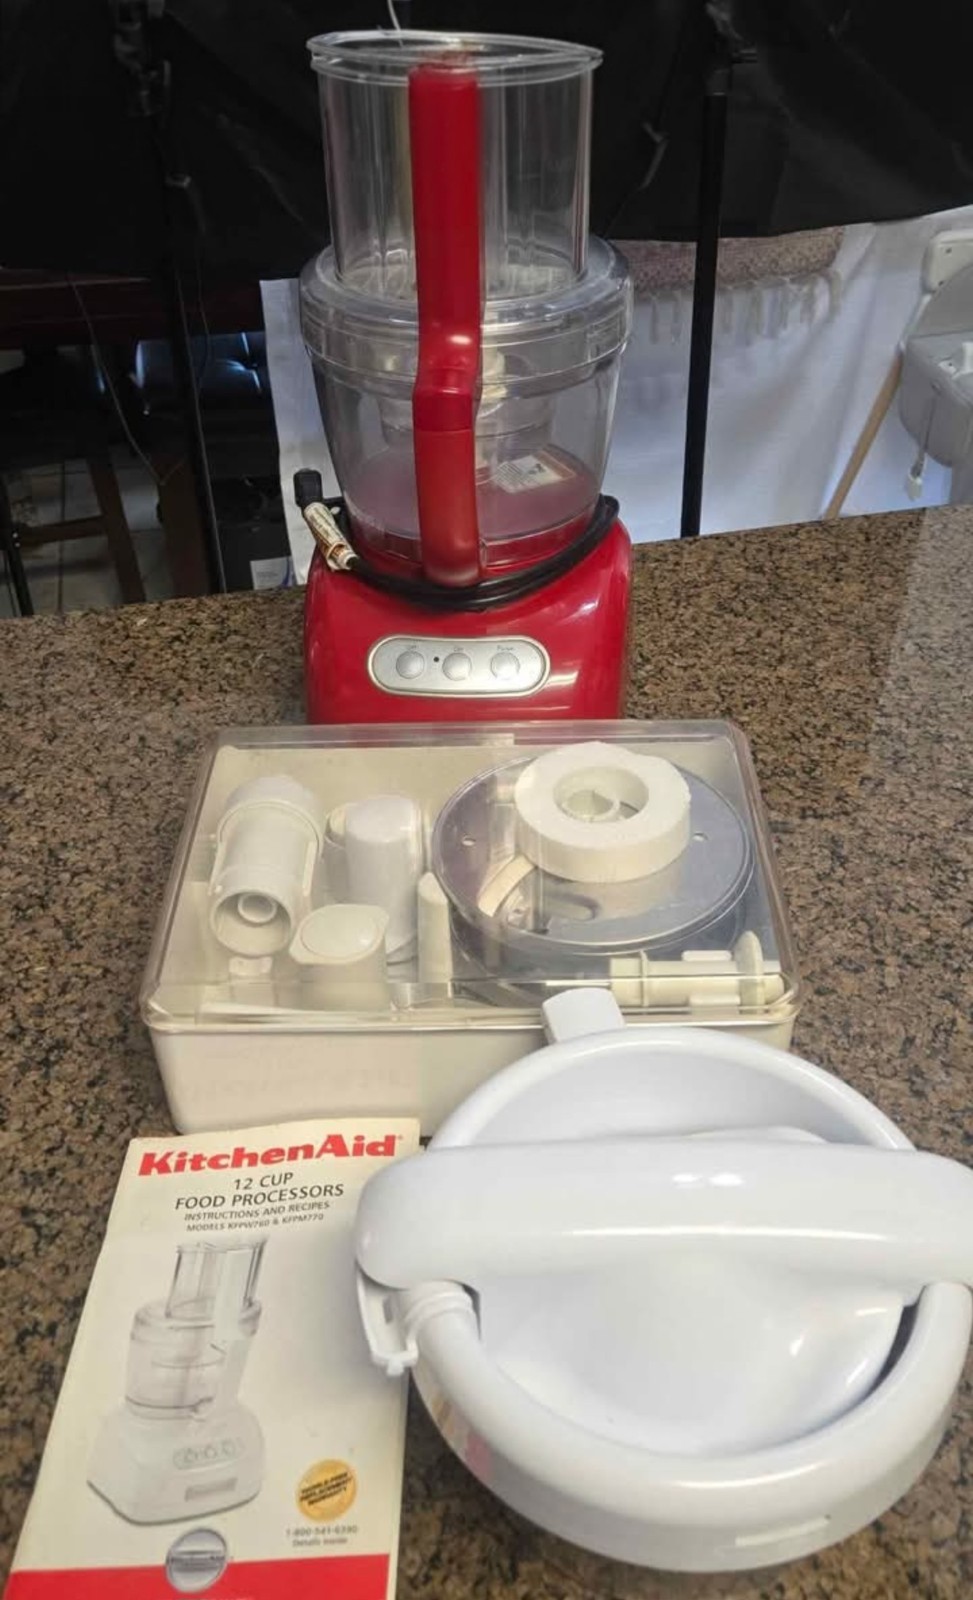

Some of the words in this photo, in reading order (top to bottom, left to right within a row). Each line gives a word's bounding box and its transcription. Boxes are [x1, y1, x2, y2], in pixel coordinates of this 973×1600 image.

[138, 1134, 397, 1176] KitchenAid
[234, 1177, 253, 1190] 12
[259, 1172, 294, 1188] CUP
[175, 1195, 226, 1210] FOOD
[231, 1184, 344, 1207] PROCESSORS
[184, 1209, 260, 1221] INSTRUCTIONS
[262, 1206, 286, 1216] AND
[288, 1201, 330, 1212] RECIPES
[186, 1222, 225, 1232] MODELS
[273, 1218, 280, 1226] &
